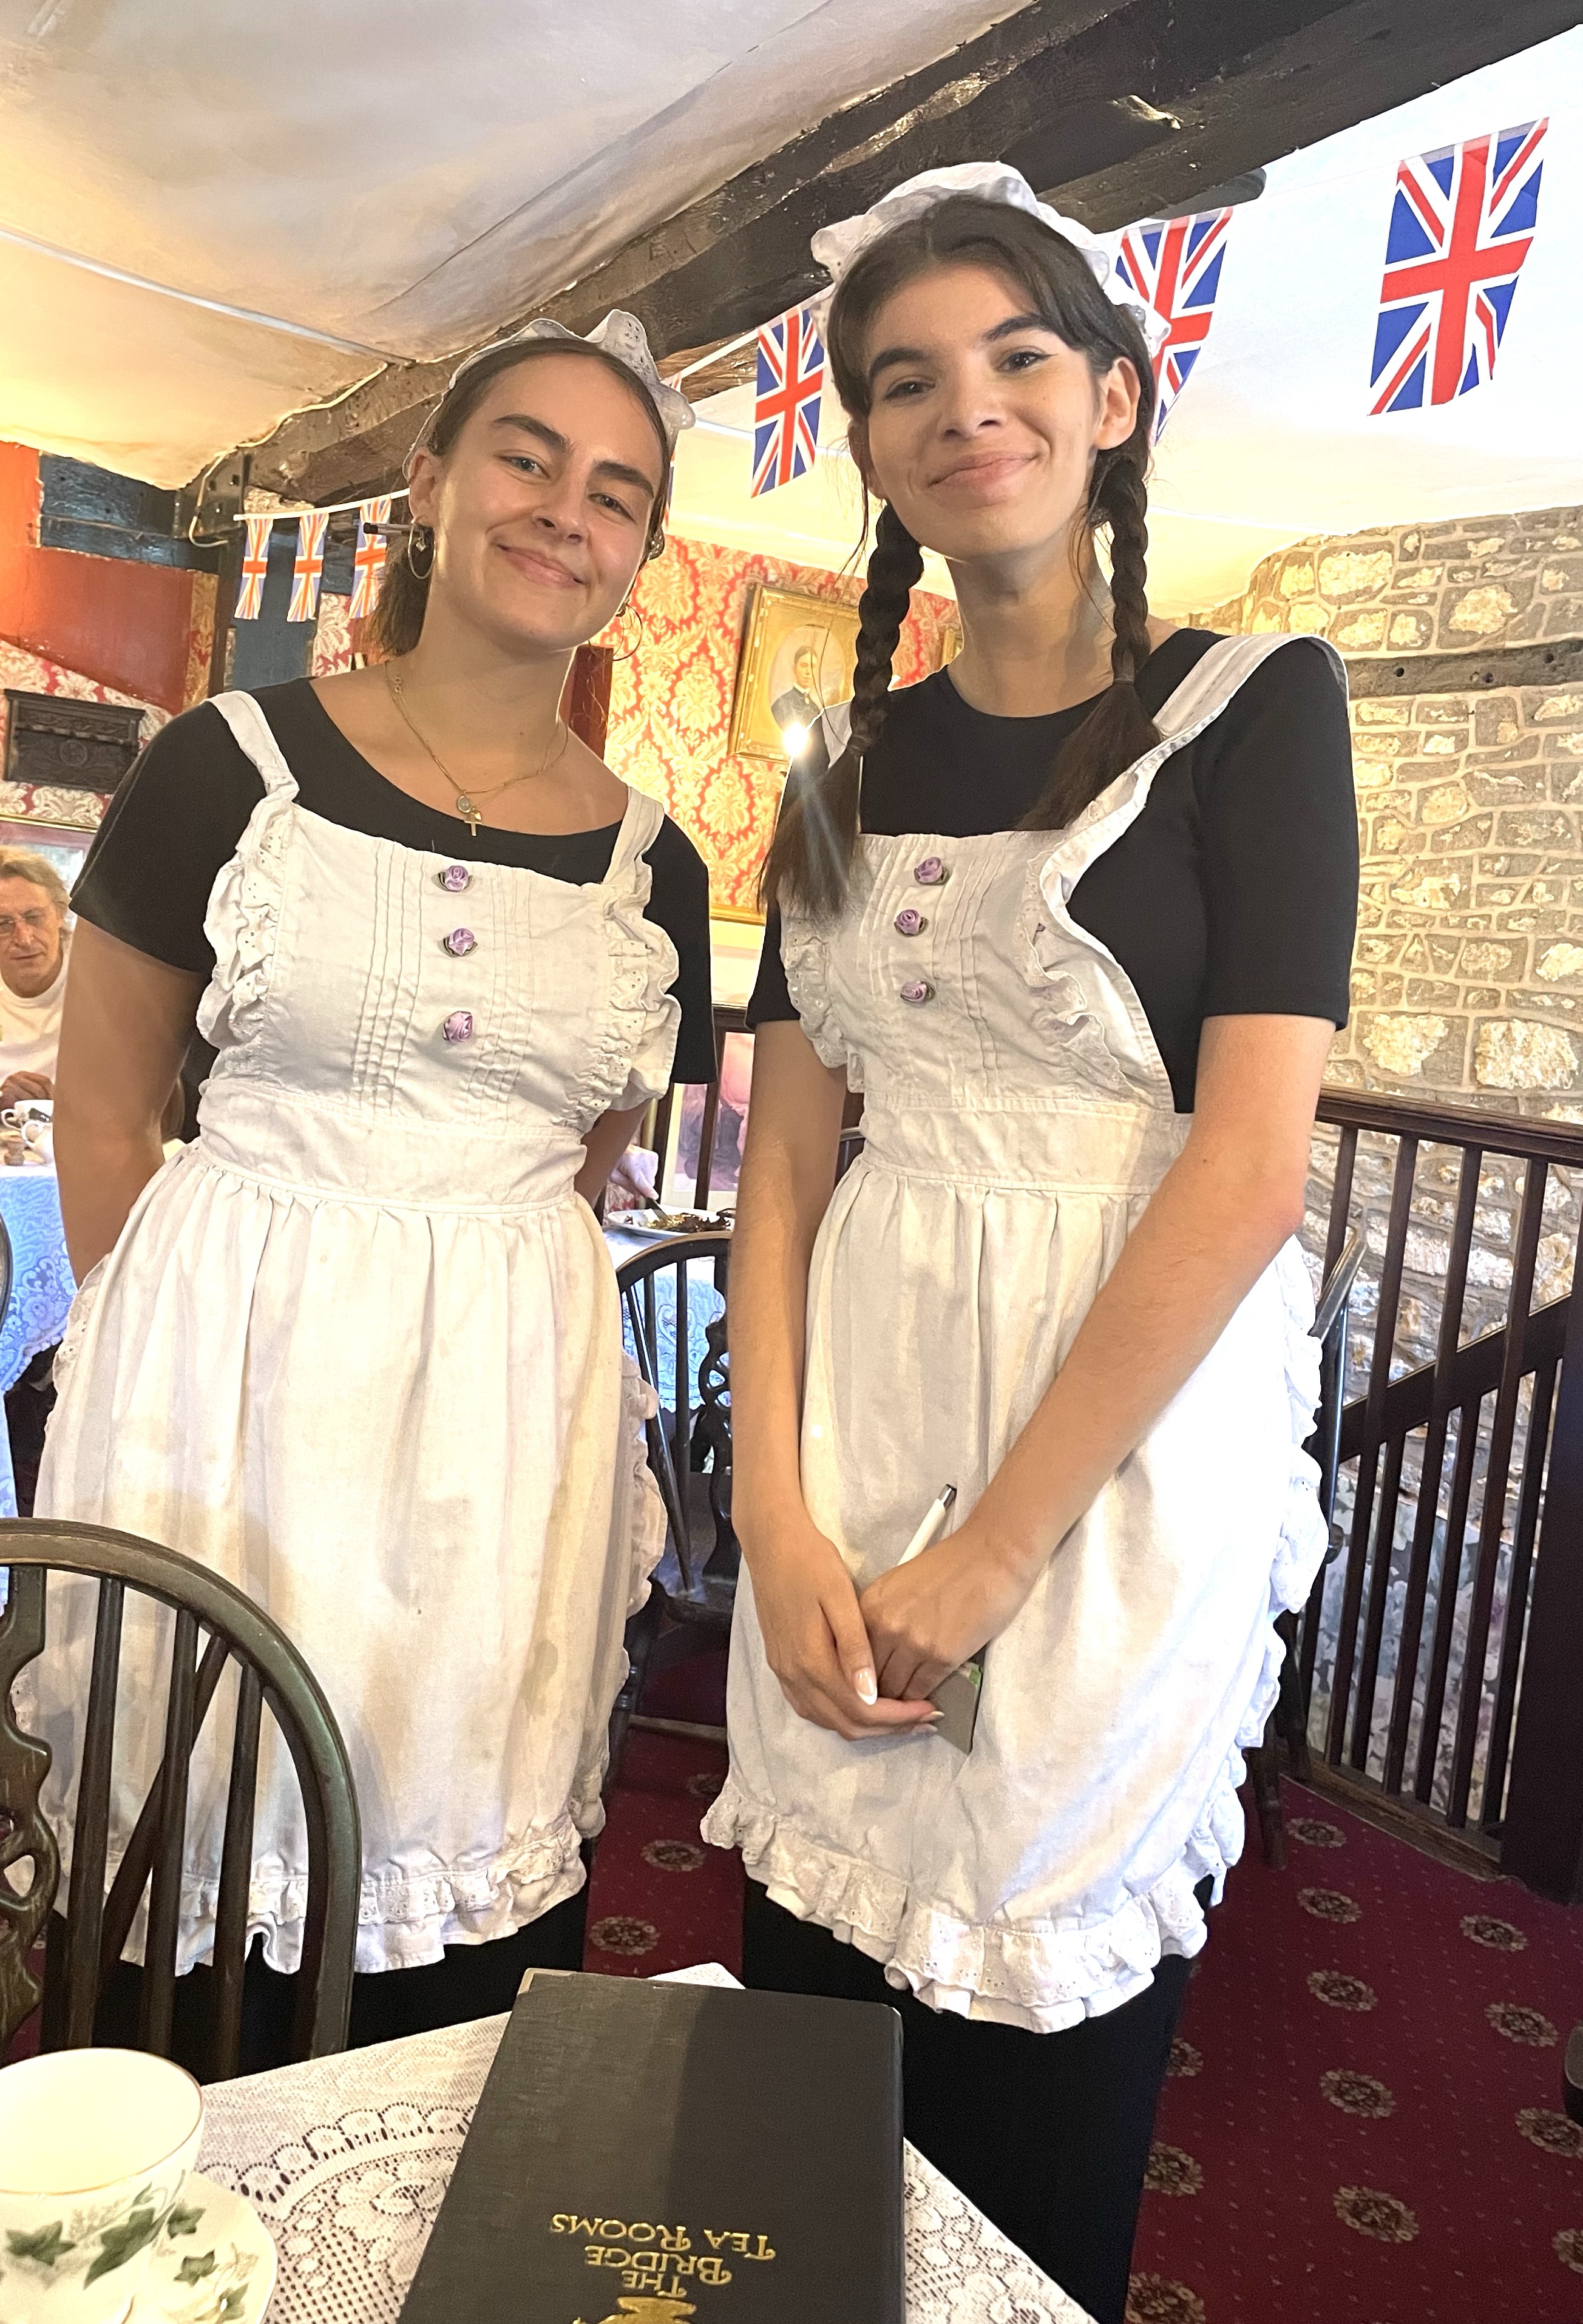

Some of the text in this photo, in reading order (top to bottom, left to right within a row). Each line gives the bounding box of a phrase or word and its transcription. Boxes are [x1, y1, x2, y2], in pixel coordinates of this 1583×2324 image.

[551, 2214, 776, 2260] TEA ROOMS
[585, 2245, 731, 2285] BRIDGE
[622, 2270, 686, 2297] THE
